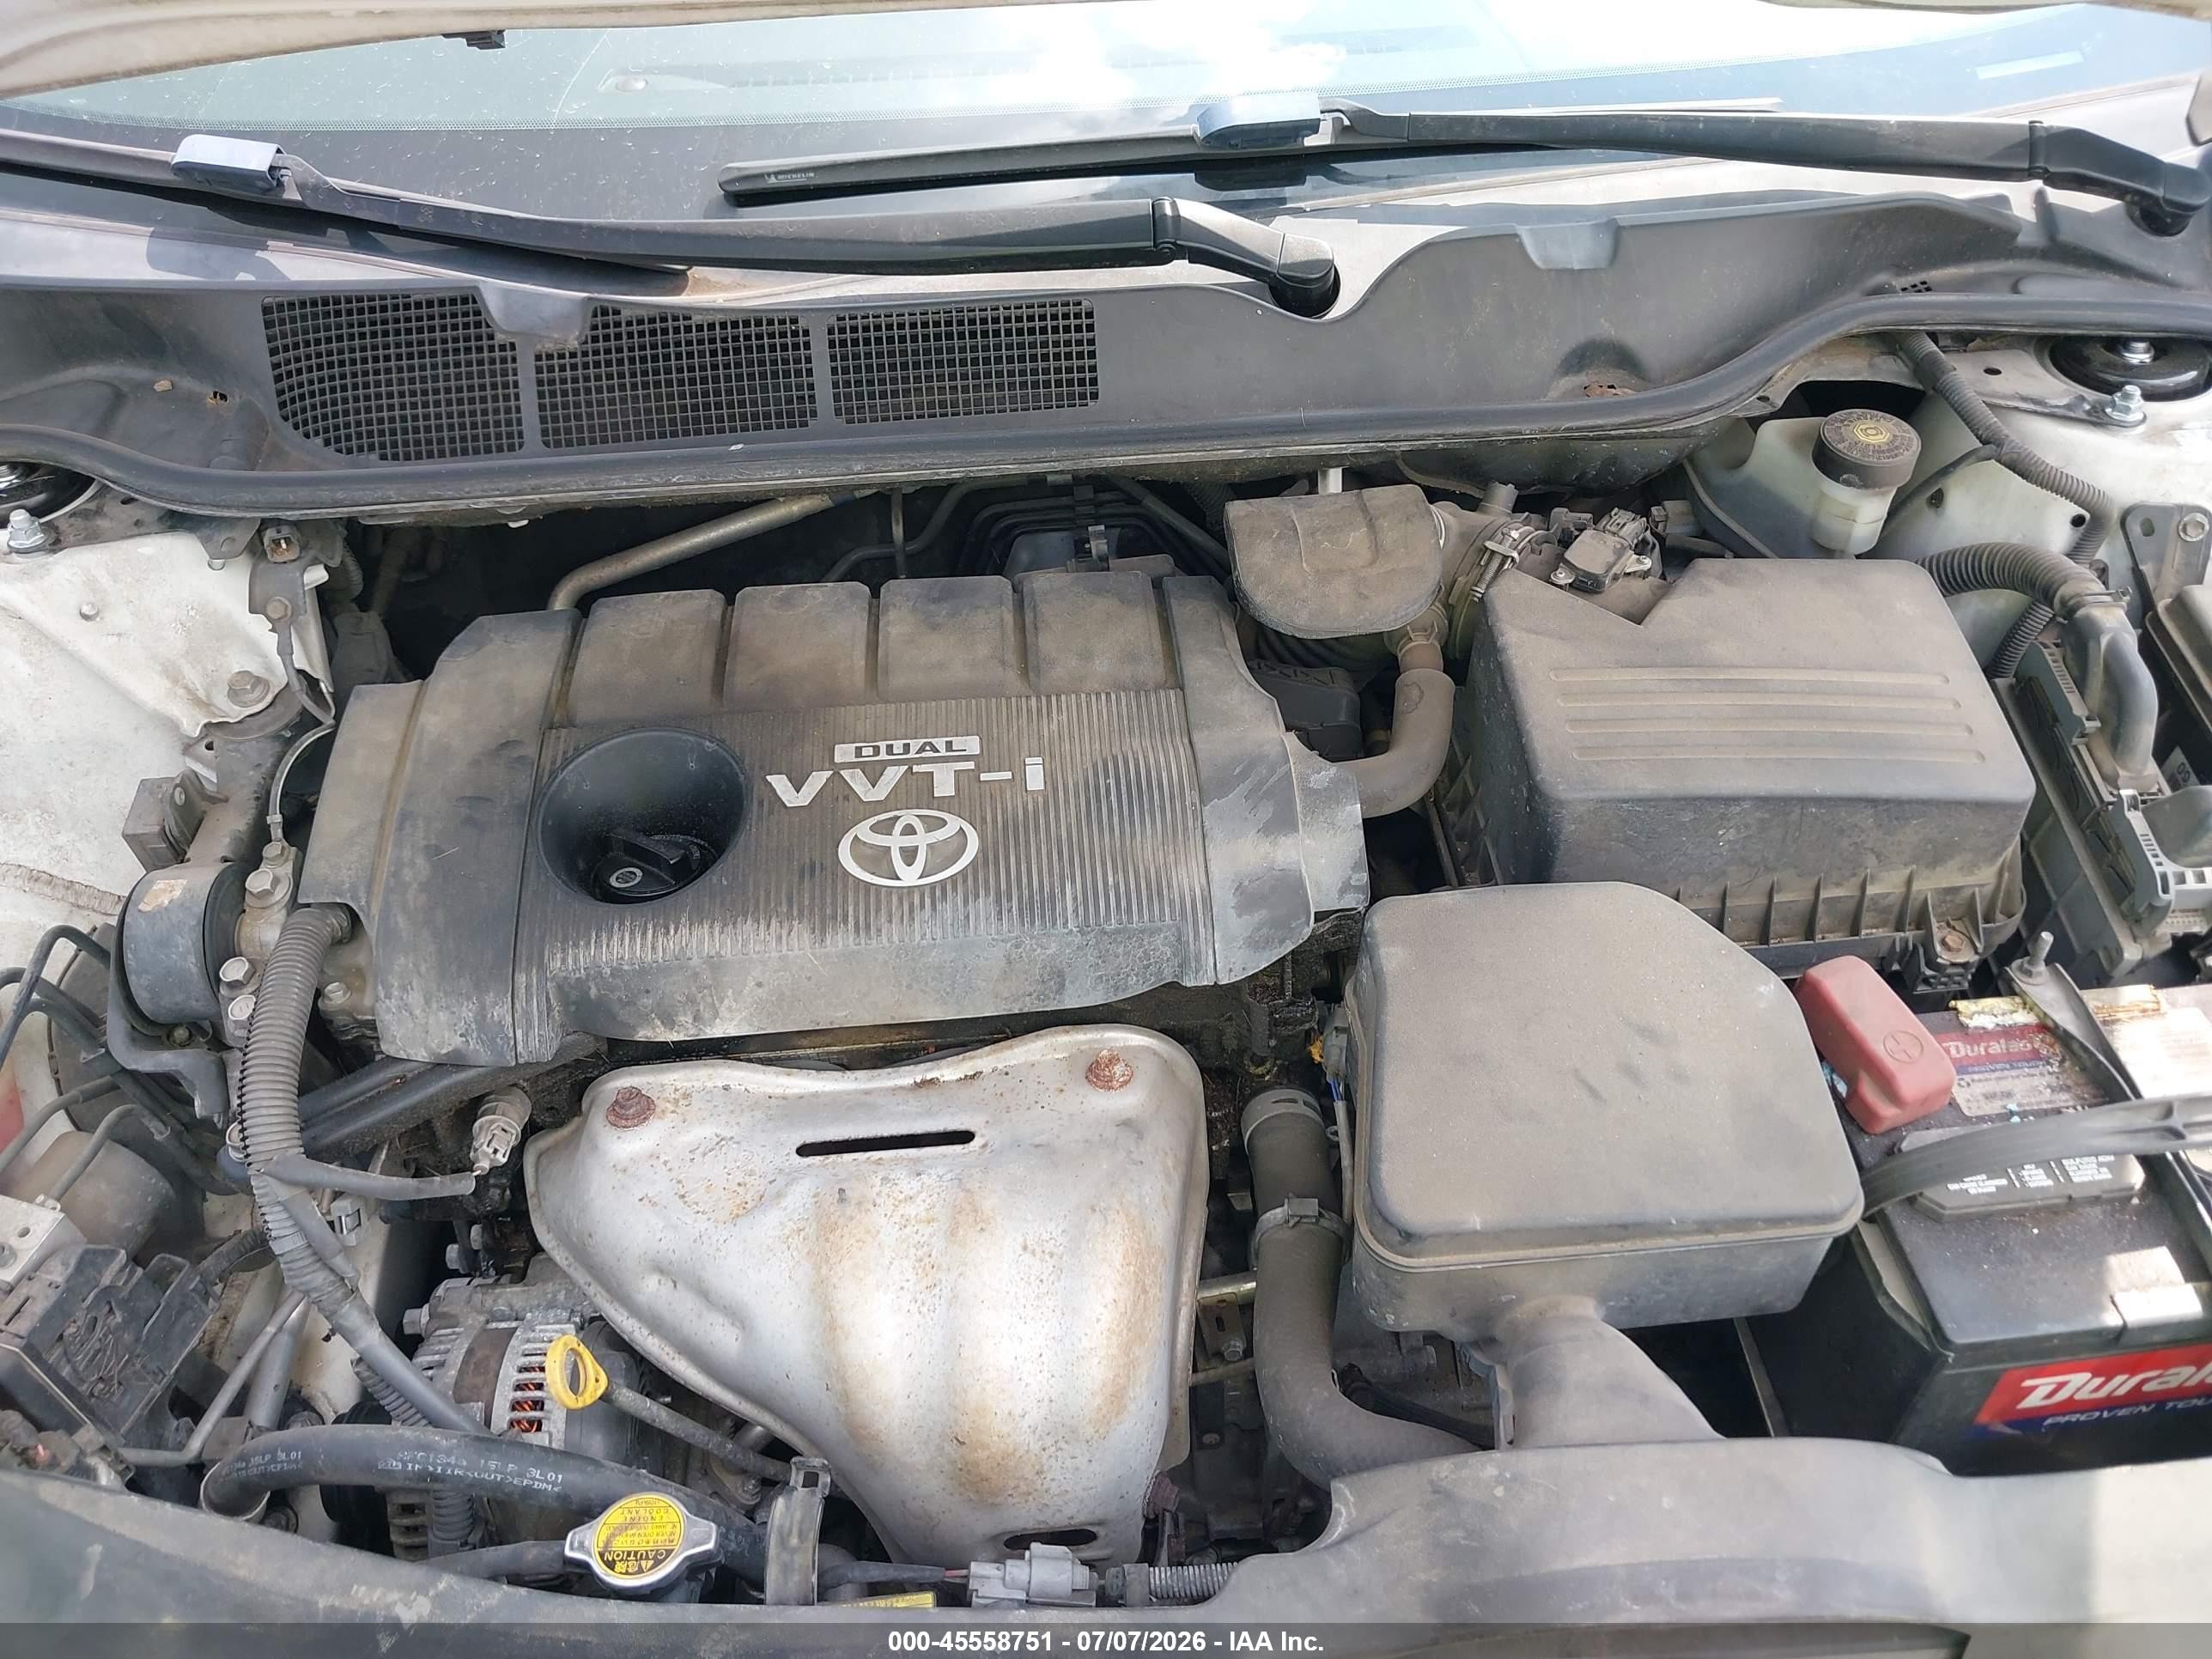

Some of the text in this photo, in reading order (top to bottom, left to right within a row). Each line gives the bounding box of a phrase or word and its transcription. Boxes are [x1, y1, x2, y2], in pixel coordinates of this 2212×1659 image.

[854, 740, 967, 758] DUAL
[766, 757, 1045, 807] VVT-i
[2043, 1403, 2156, 1425] PROVEN
[604, 1549, 666, 1561] CAUTION
